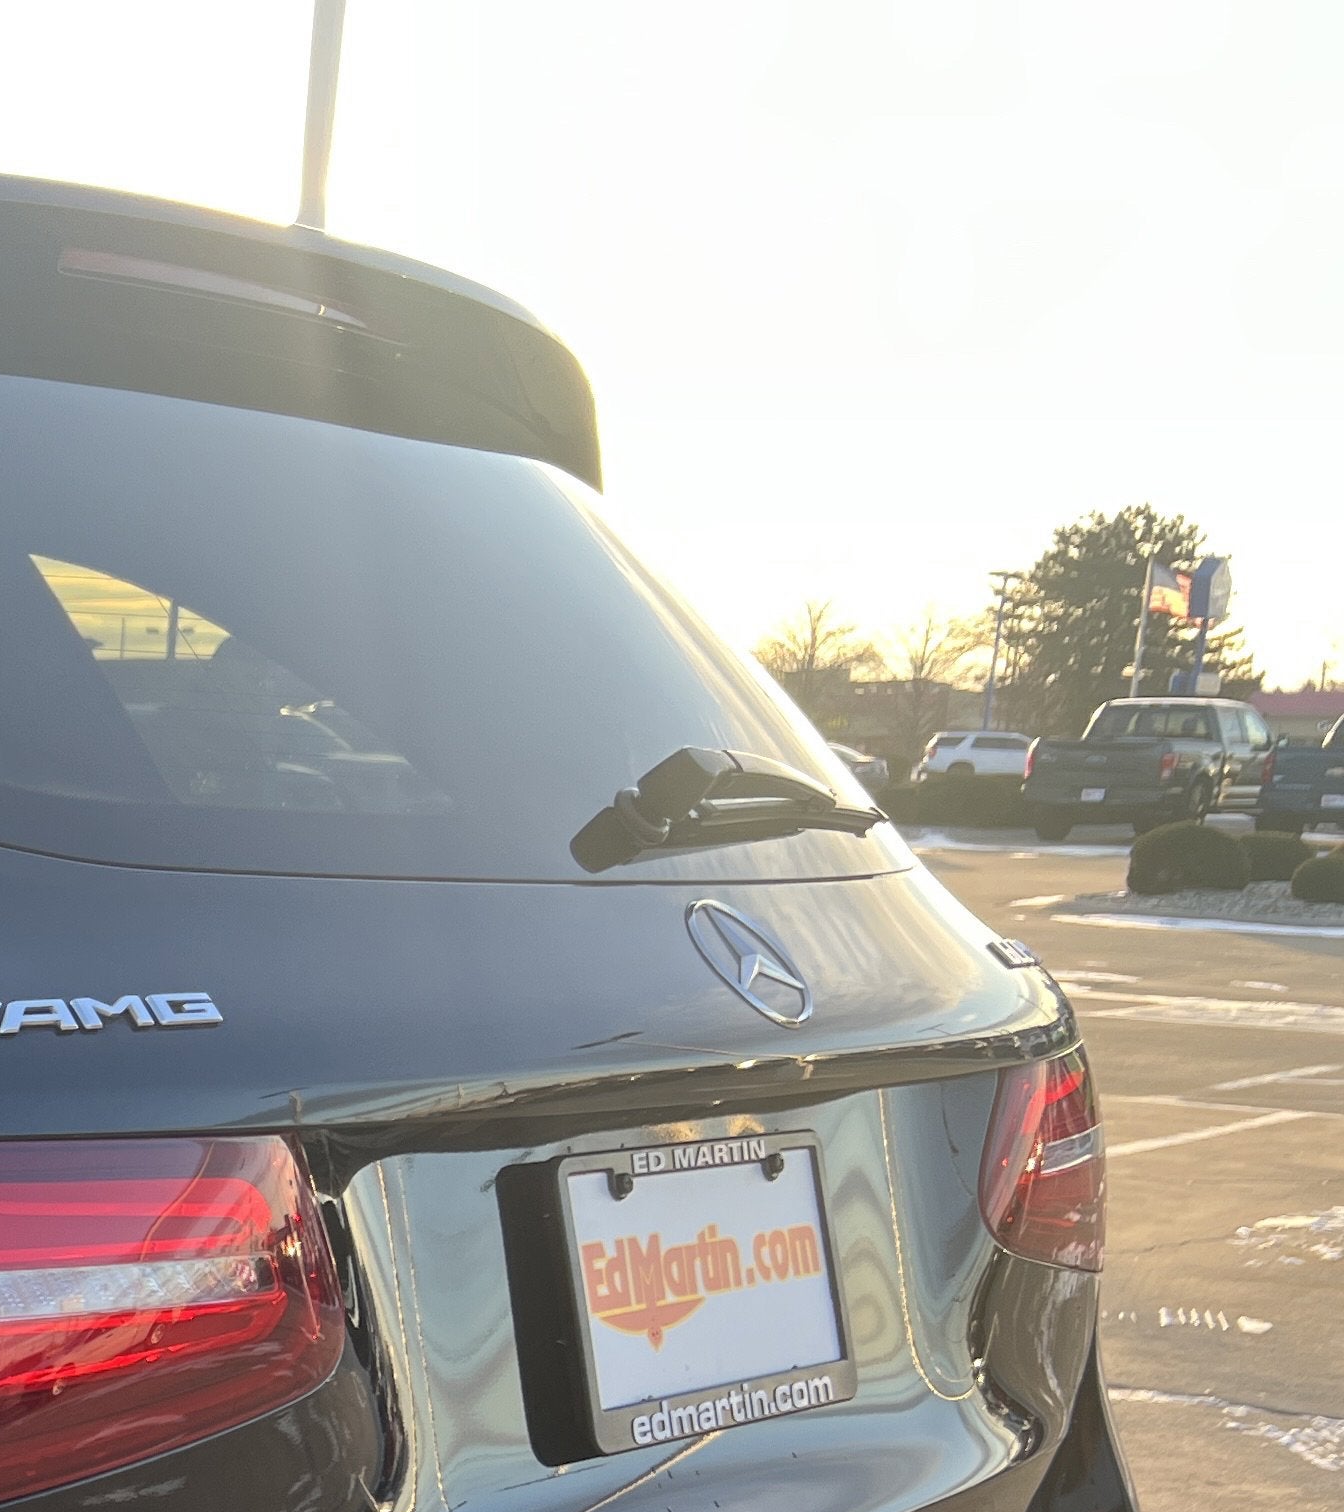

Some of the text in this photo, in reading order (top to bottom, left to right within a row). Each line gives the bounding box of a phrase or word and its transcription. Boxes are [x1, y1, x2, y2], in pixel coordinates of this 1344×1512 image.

[0, 992, 224, 1035] AMG
[631, 1139, 767, 1175] ED MARTIN
[580, 1223, 822, 1316] EdMartin.com
[631, 1373, 834, 1446] edmartin.com
